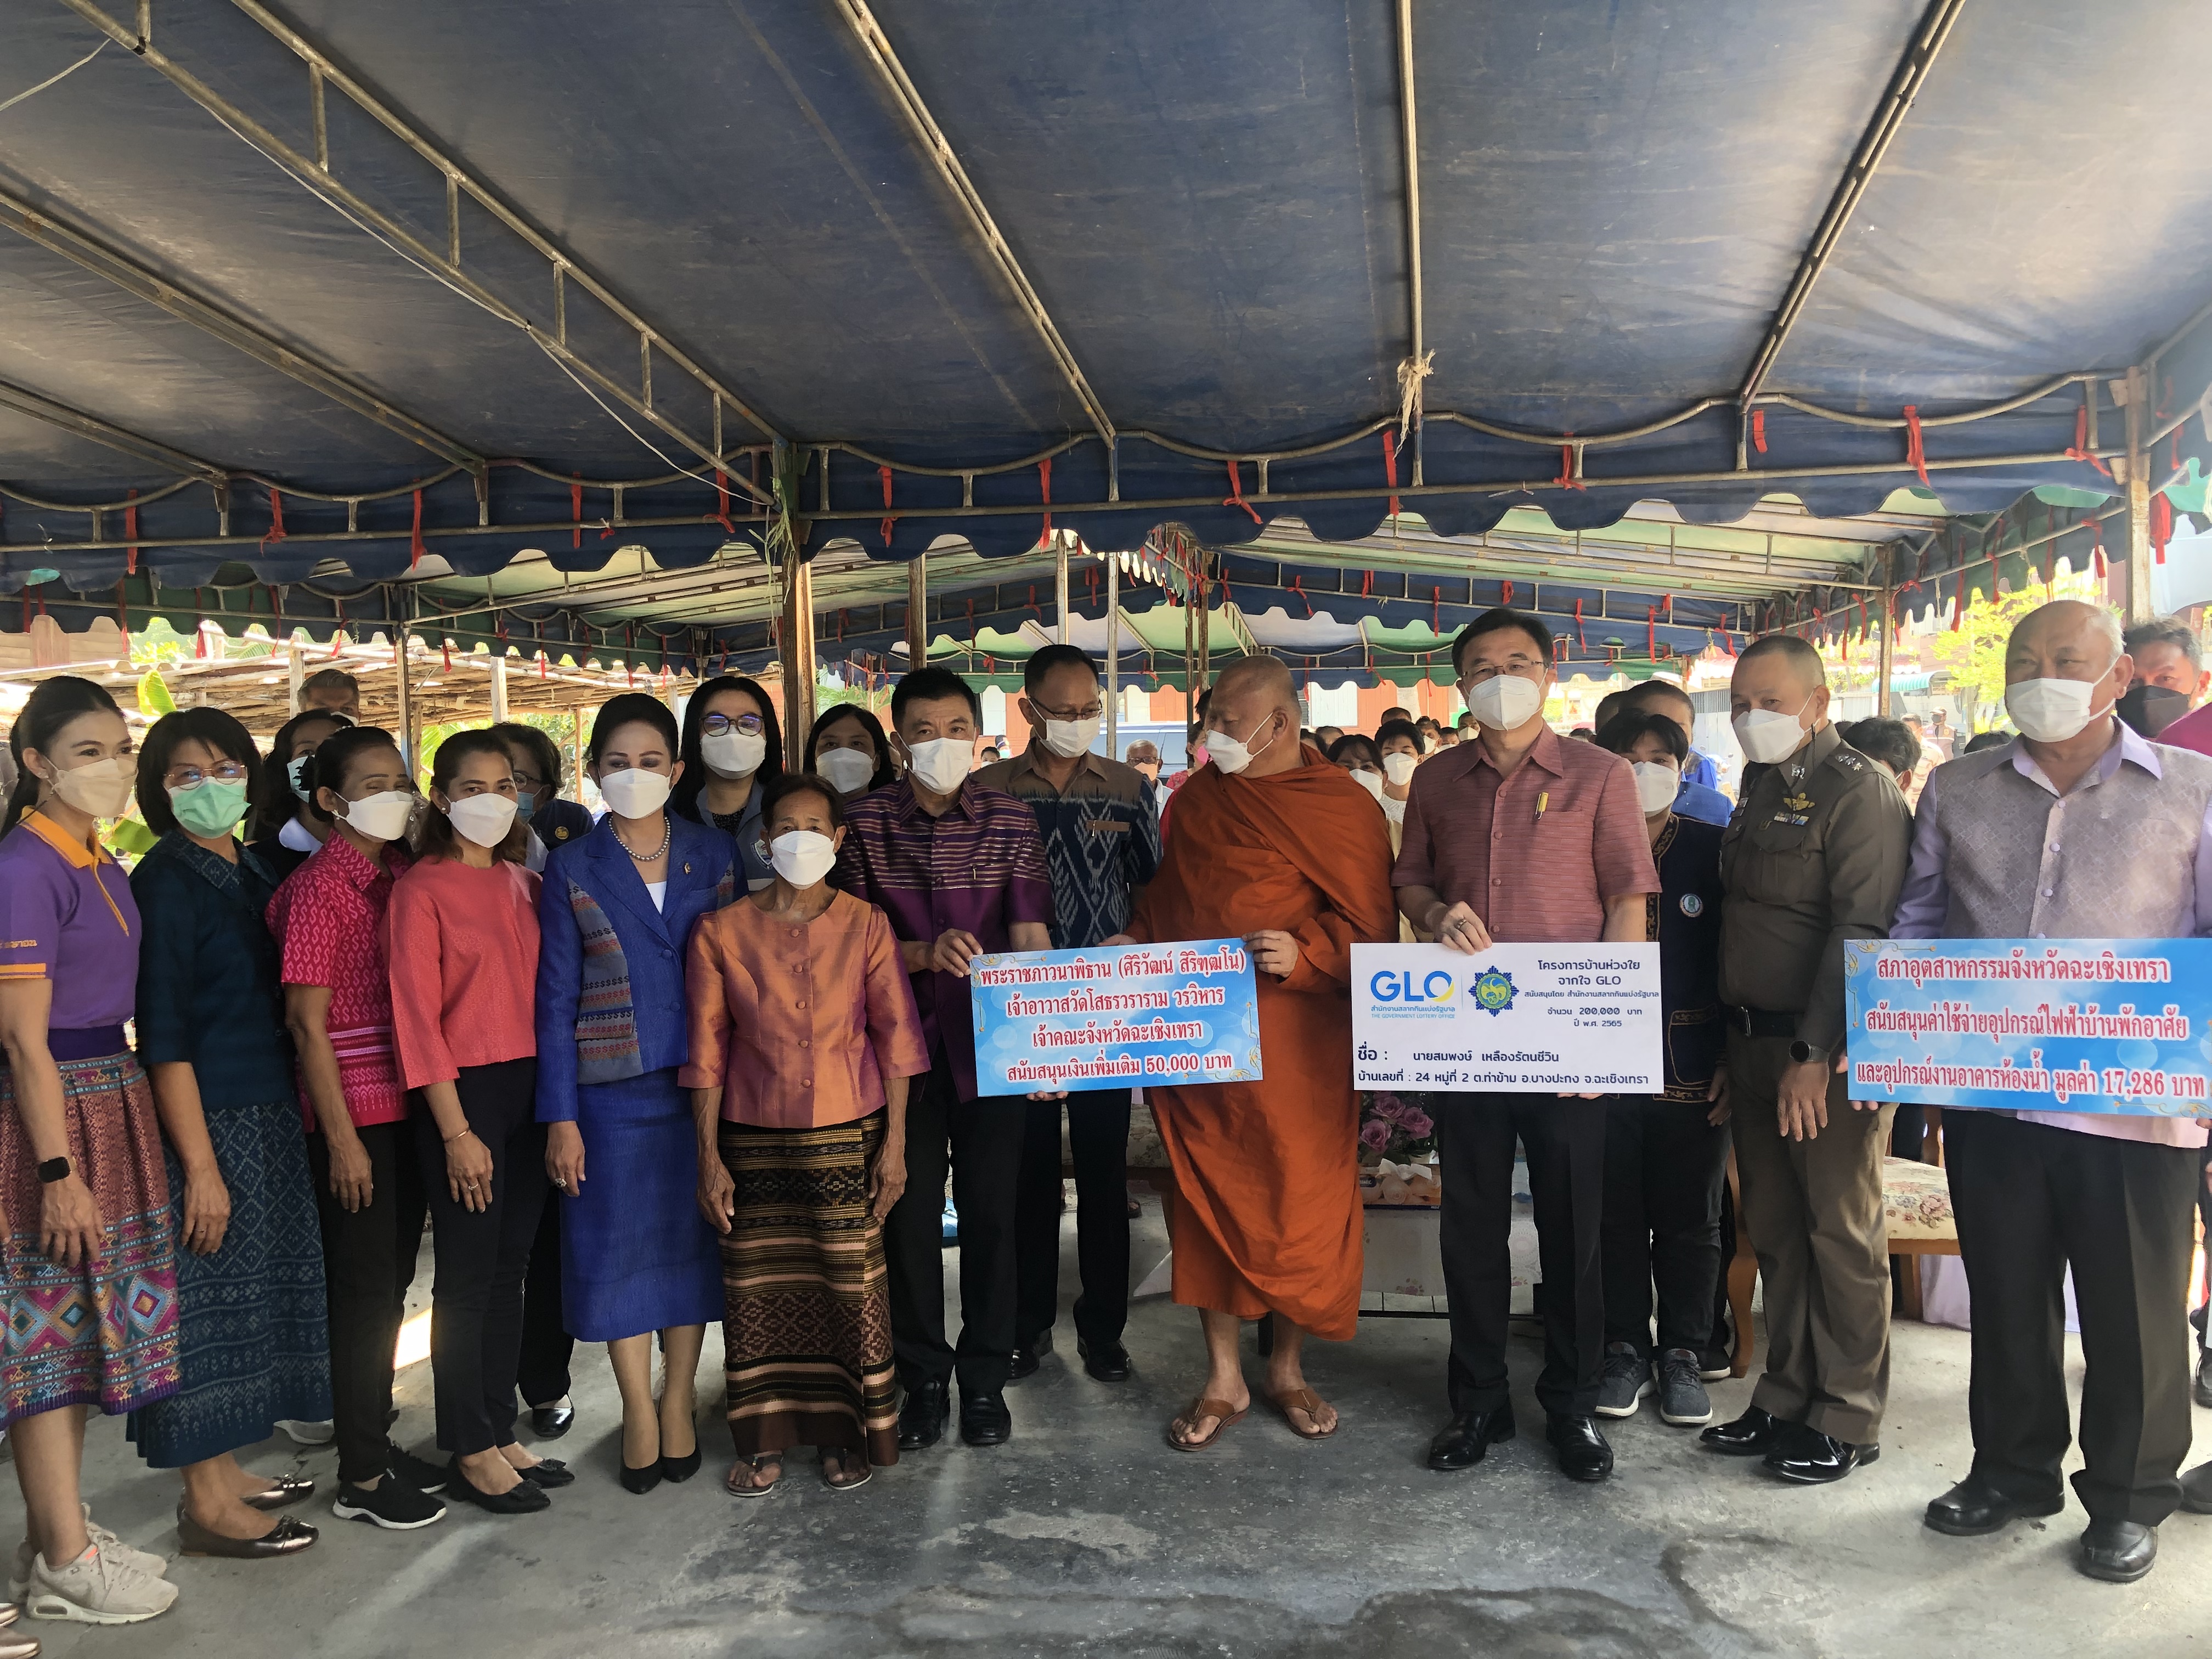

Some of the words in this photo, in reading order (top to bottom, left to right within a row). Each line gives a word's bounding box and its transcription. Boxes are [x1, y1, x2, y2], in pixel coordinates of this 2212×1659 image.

[980, 957, 1112, 985] พระราชภาวนาพิธาน
[1118, 950, 1173, 979] (ศิริวัฒน์
[1537, 958, 1640, 970] โครงการบ้านห่วงใย
[1878, 949, 2169, 988] สภาอุตสาหกรรมจังหวัดฉะเชิงเทรา
[1370, 970, 1455, 1002] GLO
[1558, 975, 1591, 985] จากใจ
[1595, 975, 1621, 985] GLO
[1007, 988, 1167, 1017] เจ้าอาวาสวัดโสธรวราราม
[1176, 984, 1223, 1005] วรวิหาร
[1547, 1007, 1572, 1015] จำนวน
[1579, 1007, 1620, 1016] 200,000
[1032, 1018, 1202, 1047] เจ้าคณะจังหวัดฉะเชิงเทรา
[1573, 1018, 1579, 1027] ปี
[1358, 1041, 1378, 1061] ชื่อ
[1413, 1050, 1472, 1061] นายสมพงษ์
[1482, 1050, 1559, 1062] เหลืองรัตนชีวิน
[1007, 1049, 1140, 1085] สนับสนุนเงินเพิ่มเติม
[1147, 1055, 1199, 1075] 50,000
[1205, 1055, 1232, 1069] บาท
[1358, 1068, 1404, 1082] บ้านเลขที่
[1415, 1072, 1430, 1082] 24
[1435, 1068, 1457, 1086] หมู่ที่
[1462, 1073, 1469, 1082] 2
[1474, 1071, 1516, 1083] ต.ท่าข้าม
[1521, 1073, 1579, 1084] อ.บางปะกง
[1584, 1073, 1649, 1084] จ.ฉะเชิงเทรา
[1858, 1050, 2048, 1093] และอุปกรณ์งานอาคารห้องน้ำ
[2055, 1062, 2096, 1101] มูลค่า
[2104, 1071, 2164, 1099] 17,286
[2171, 1076, 2204, 1097] บาท
